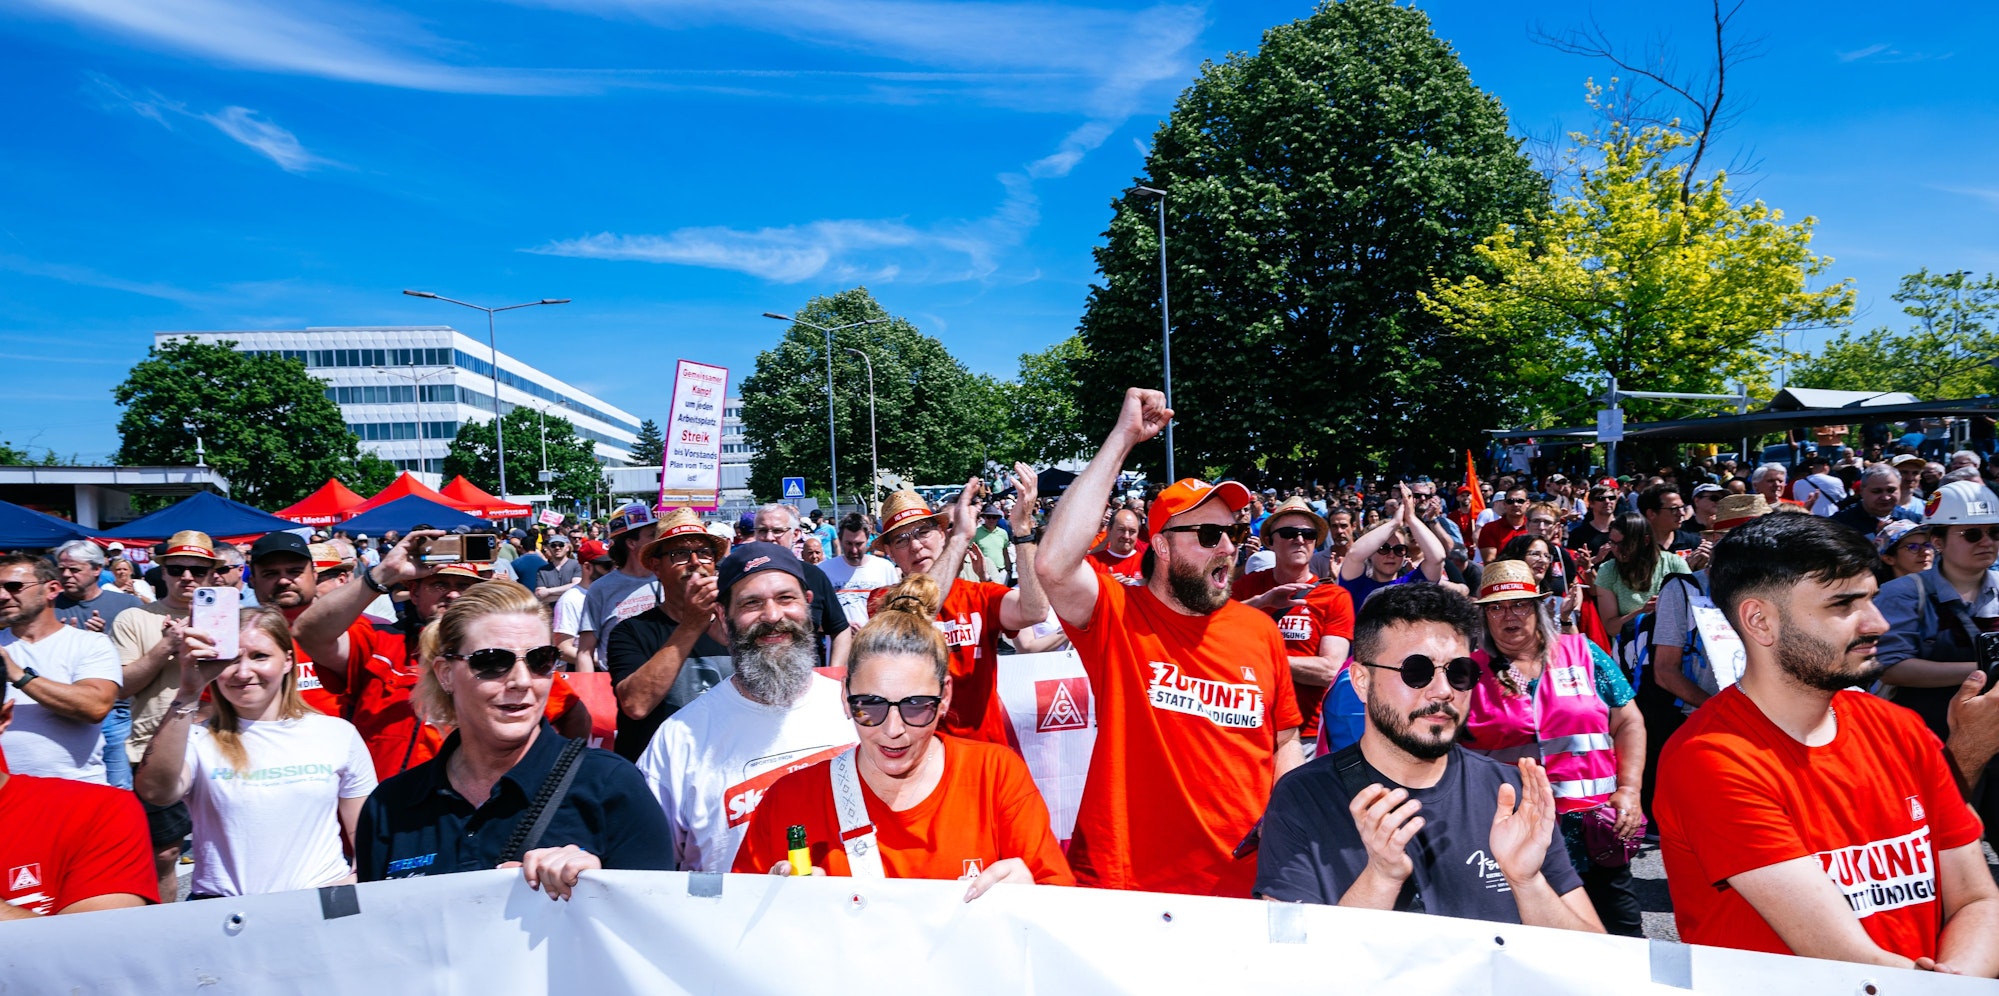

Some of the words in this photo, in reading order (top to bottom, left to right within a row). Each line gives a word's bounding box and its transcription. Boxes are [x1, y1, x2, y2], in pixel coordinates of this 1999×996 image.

[692, 385, 712, 396] Kampf
[696, 401, 713, 411] jeden
[678, 414, 716, 426] Arbeitsplatz
[682, 430, 709, 442] Streik
[670, 461, 683, 469] Plan
[699, 462, 714, 470] Tisch
[1156, 691, 1194, 710] STATT
